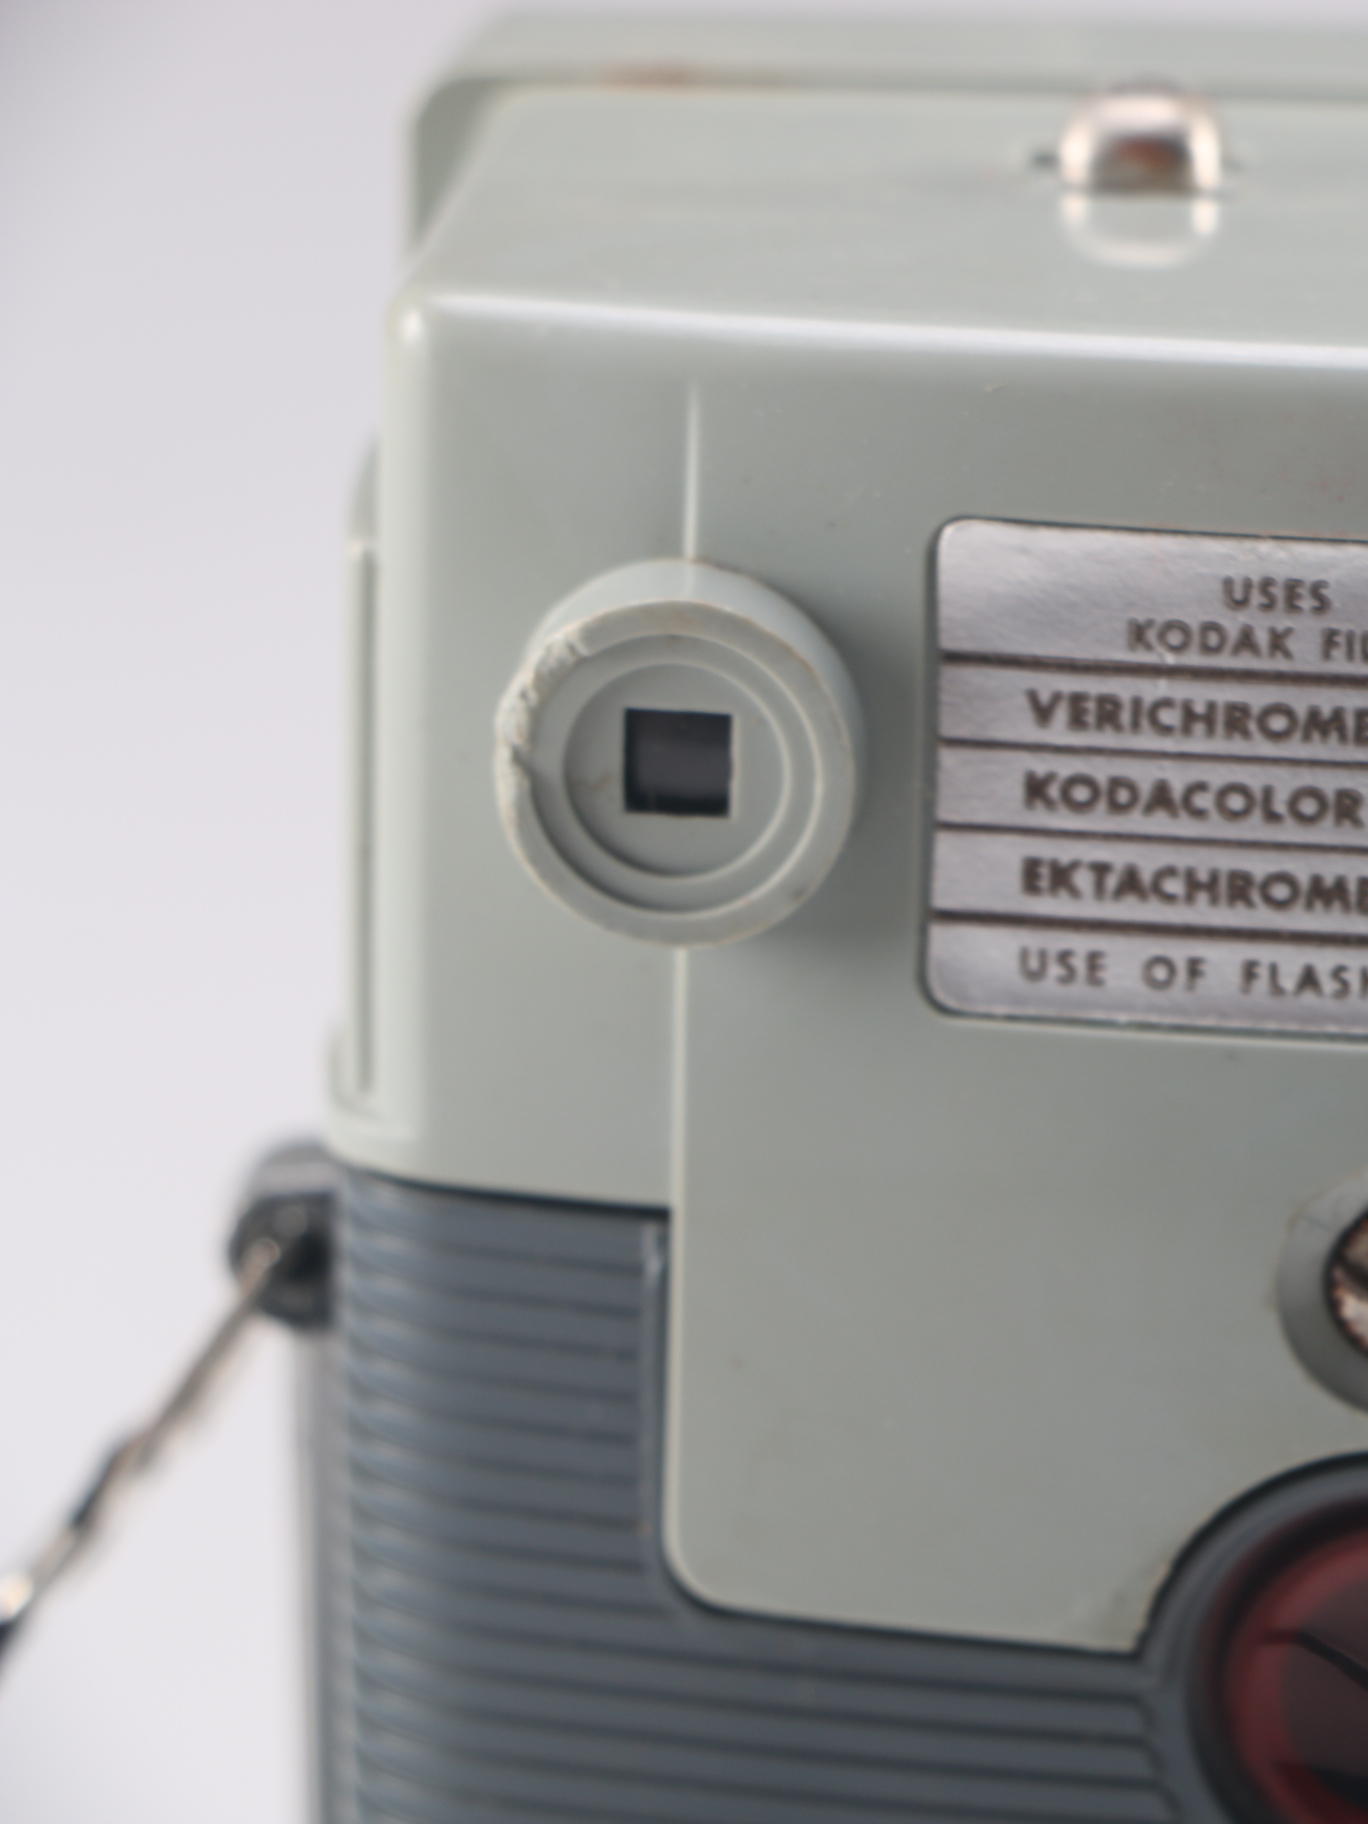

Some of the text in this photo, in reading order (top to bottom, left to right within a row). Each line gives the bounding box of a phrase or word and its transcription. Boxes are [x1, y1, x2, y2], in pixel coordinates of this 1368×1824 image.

[1222, 576, 1332, 614] USES
[1127, 618, 1295, 660] KODAK
[1022, 771, 1367, 829] KODACOLOR
[1019, 947, 1107, 988] USE
[1142, 955, 1207, 991] OF
